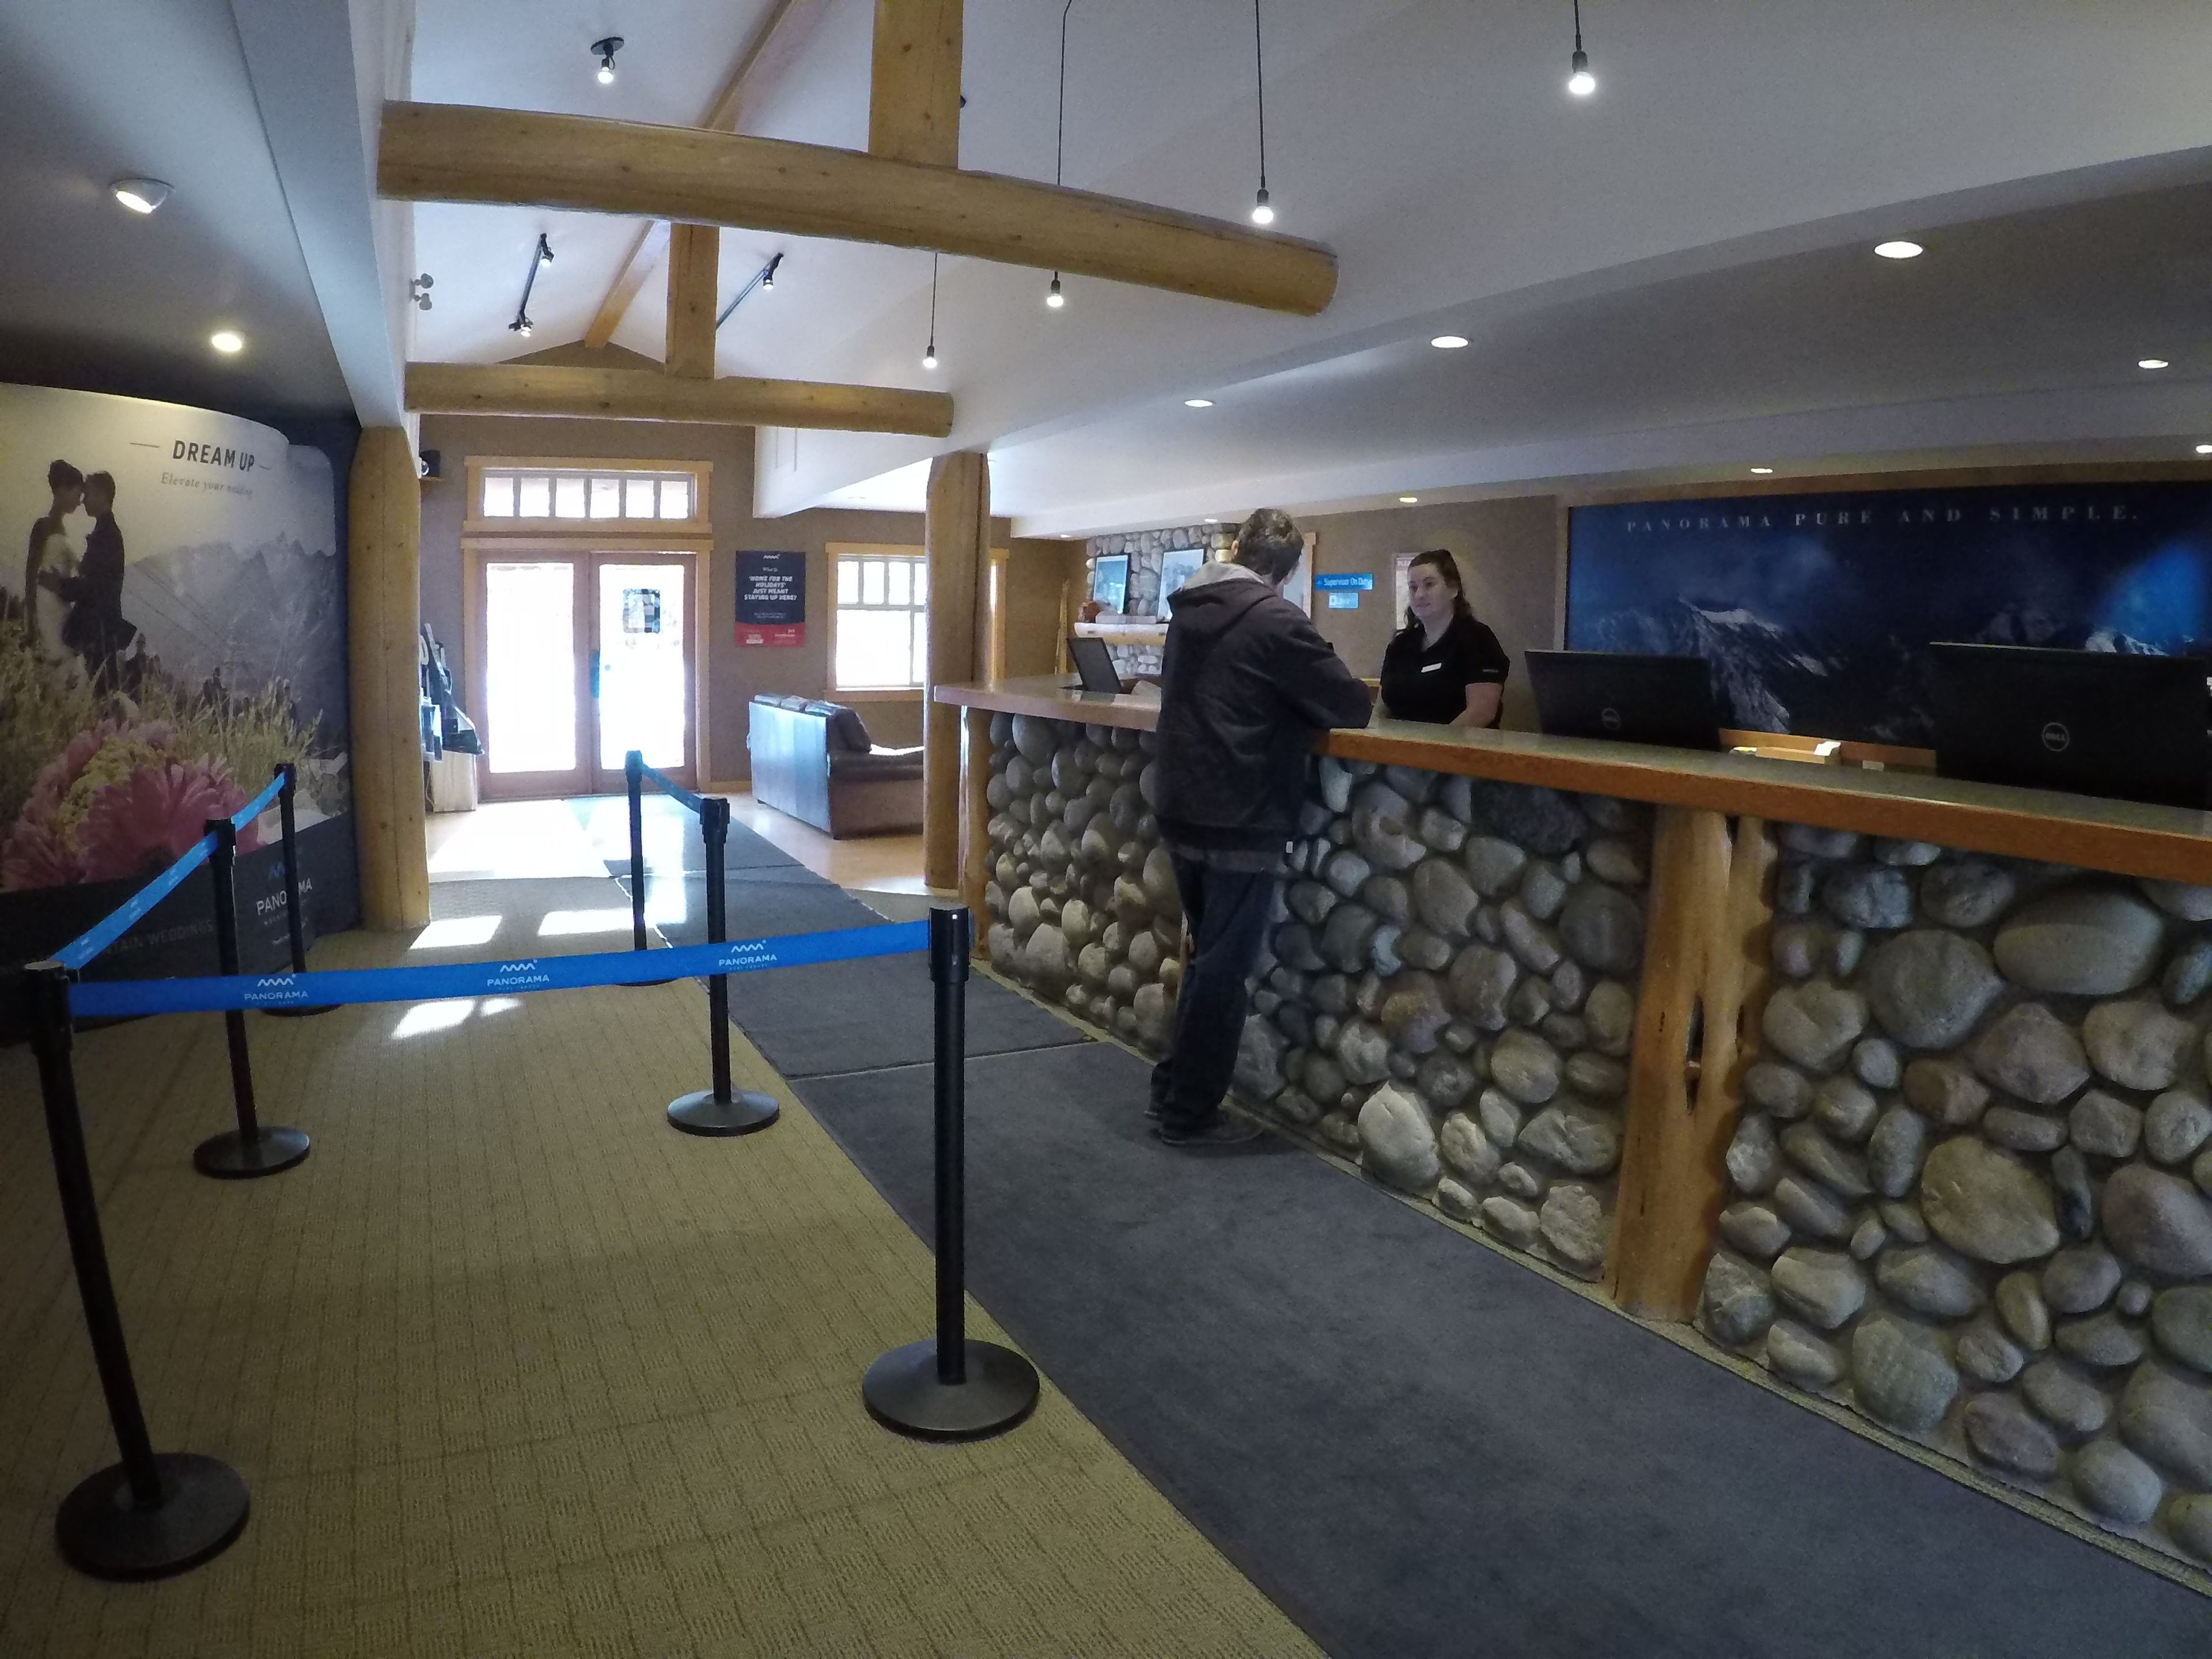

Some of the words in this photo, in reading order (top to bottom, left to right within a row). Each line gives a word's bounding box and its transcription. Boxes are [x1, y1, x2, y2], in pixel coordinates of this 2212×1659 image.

[172, 440, 236, 468] DREAM
[239, 452, 255, 472] UP
[161, 472, 200, 488] Elevate
[1627, 516, 1771, 532] PANORAMA
[1794, 512, 1872, 526] PURE
[1902, 508, 1960, 522] AND
[1989, 505, 2137, 521] SIMPLE.
[1324, 578, 1350, 588] Supervisor
[1350, 577, 1358, 585] On
[1358, 577, 1372, 587] Duty
[256, 877, 313, 915] PANOMA
[718, 954, 777, 966] PANORAMA
[486, 974, 550, 987] PANORAMA
[244, 990, 309, 1000] PANORAMA
